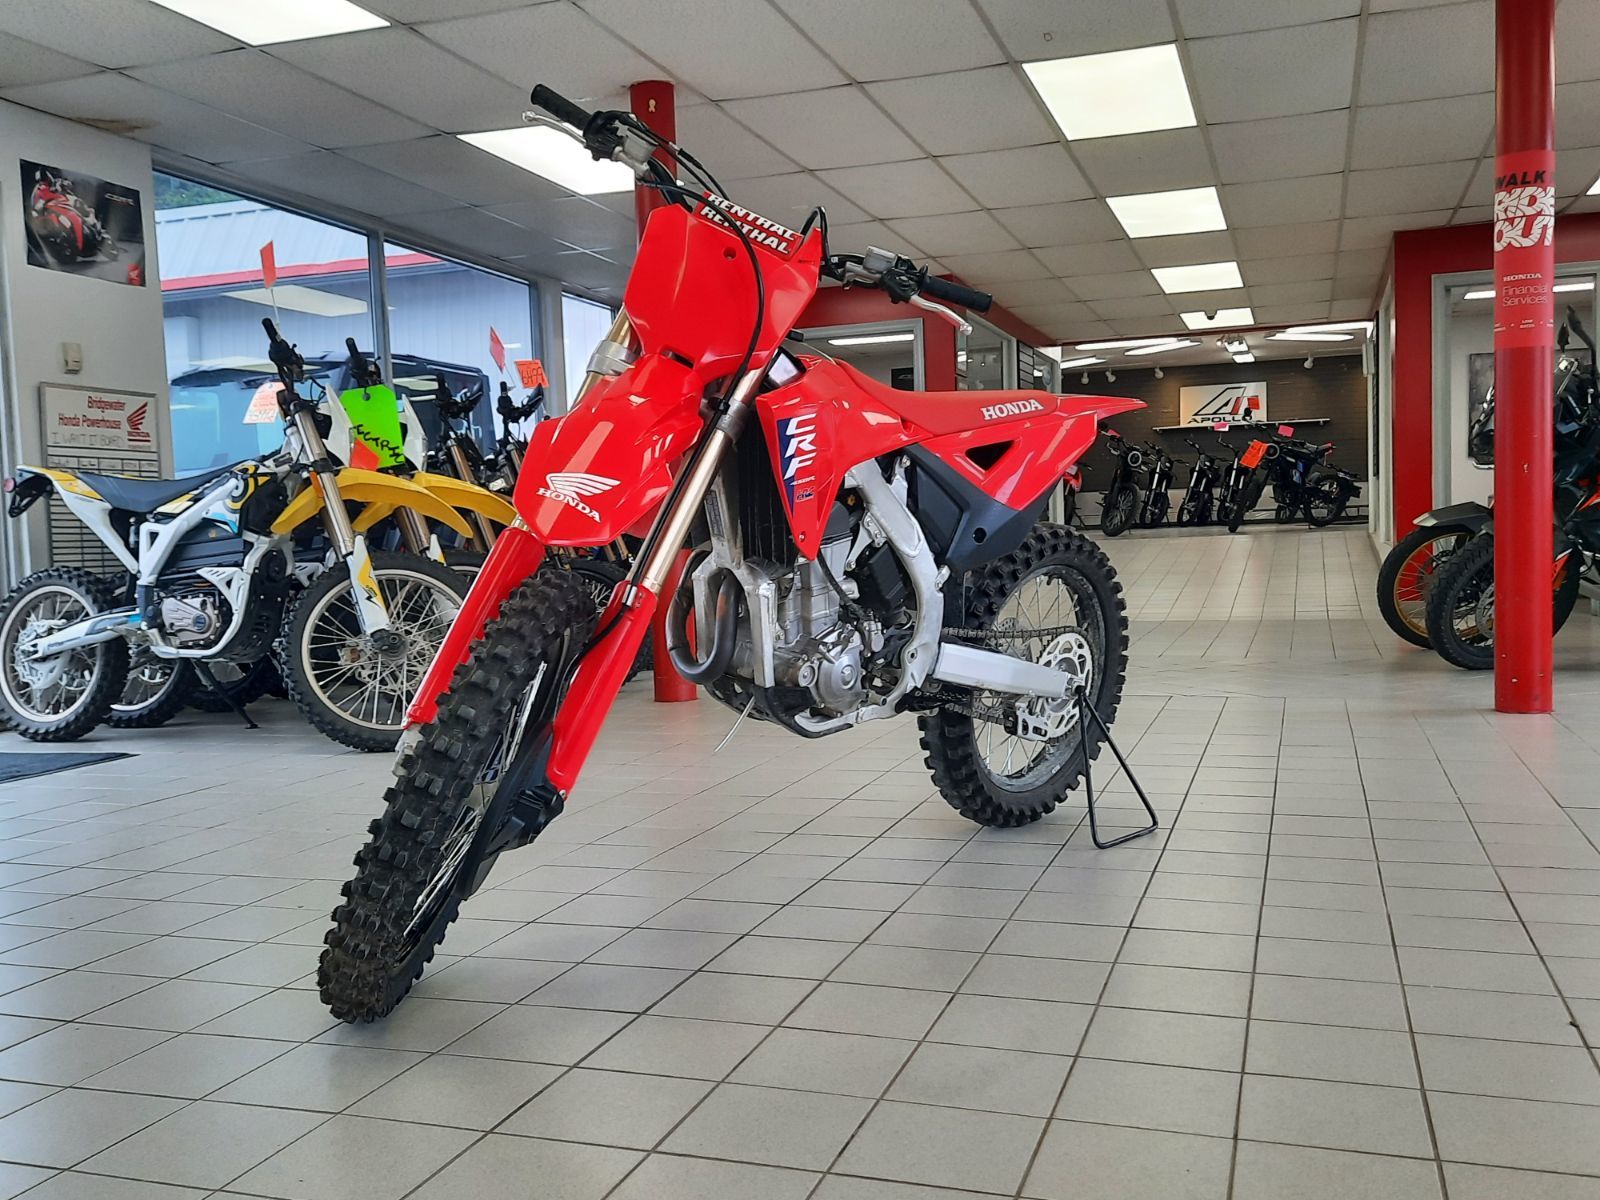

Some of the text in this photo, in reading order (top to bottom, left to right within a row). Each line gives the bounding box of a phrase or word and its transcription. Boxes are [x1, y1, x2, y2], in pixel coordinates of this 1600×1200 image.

[1495, 170, 1546, 190] WALK
[708, 193, 795, 240] RENTHAL
[1503, 273, 1542, 281] HONDA
[1503, 284, 1547, 296] Financial
[1503, 295, 1547, 307] Services
[980, 399, 1045, 421] HONDA
[58, 413, 121, 429] Honda Powerhouse
[783, 413, 817, 480] CRF
[536, 487, 601, 523] HONDA
